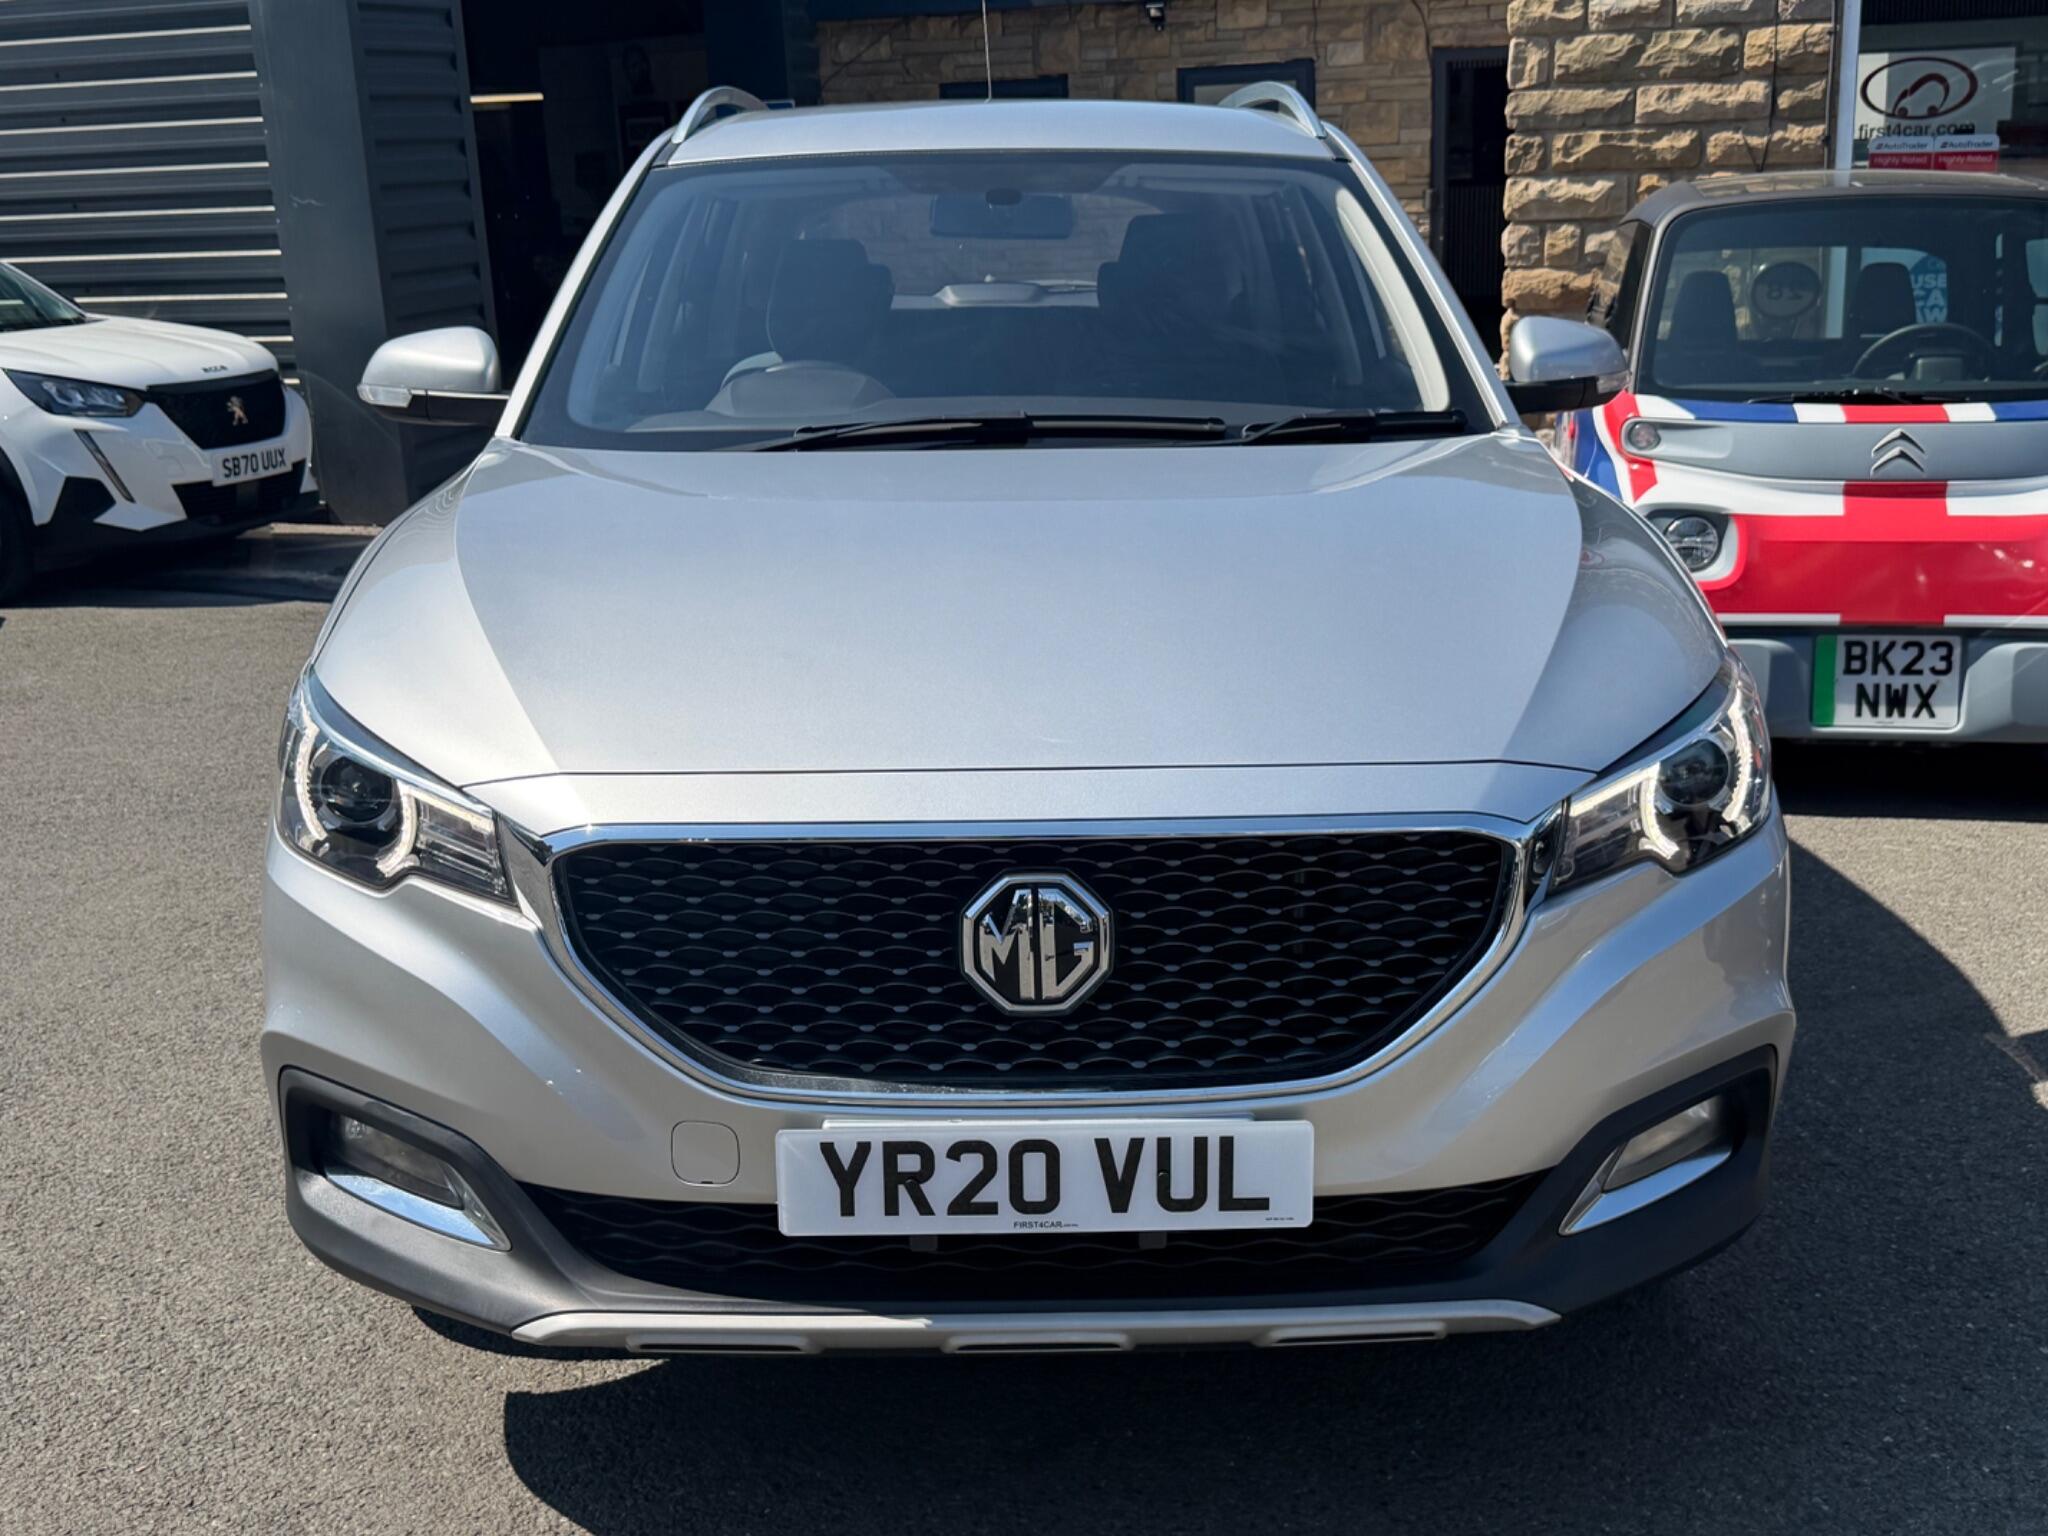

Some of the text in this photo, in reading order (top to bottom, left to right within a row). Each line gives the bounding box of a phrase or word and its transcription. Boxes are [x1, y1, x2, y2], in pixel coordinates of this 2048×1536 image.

[222, 447, 287, 478] SB70 UUX
[1842, 640, 1954, 676] BK23
[1854, 683, 1938, 718] NWX
[979, 887, 1094, 1000] MG
[819, 1135, 1270, 1217] YR20 VUL
